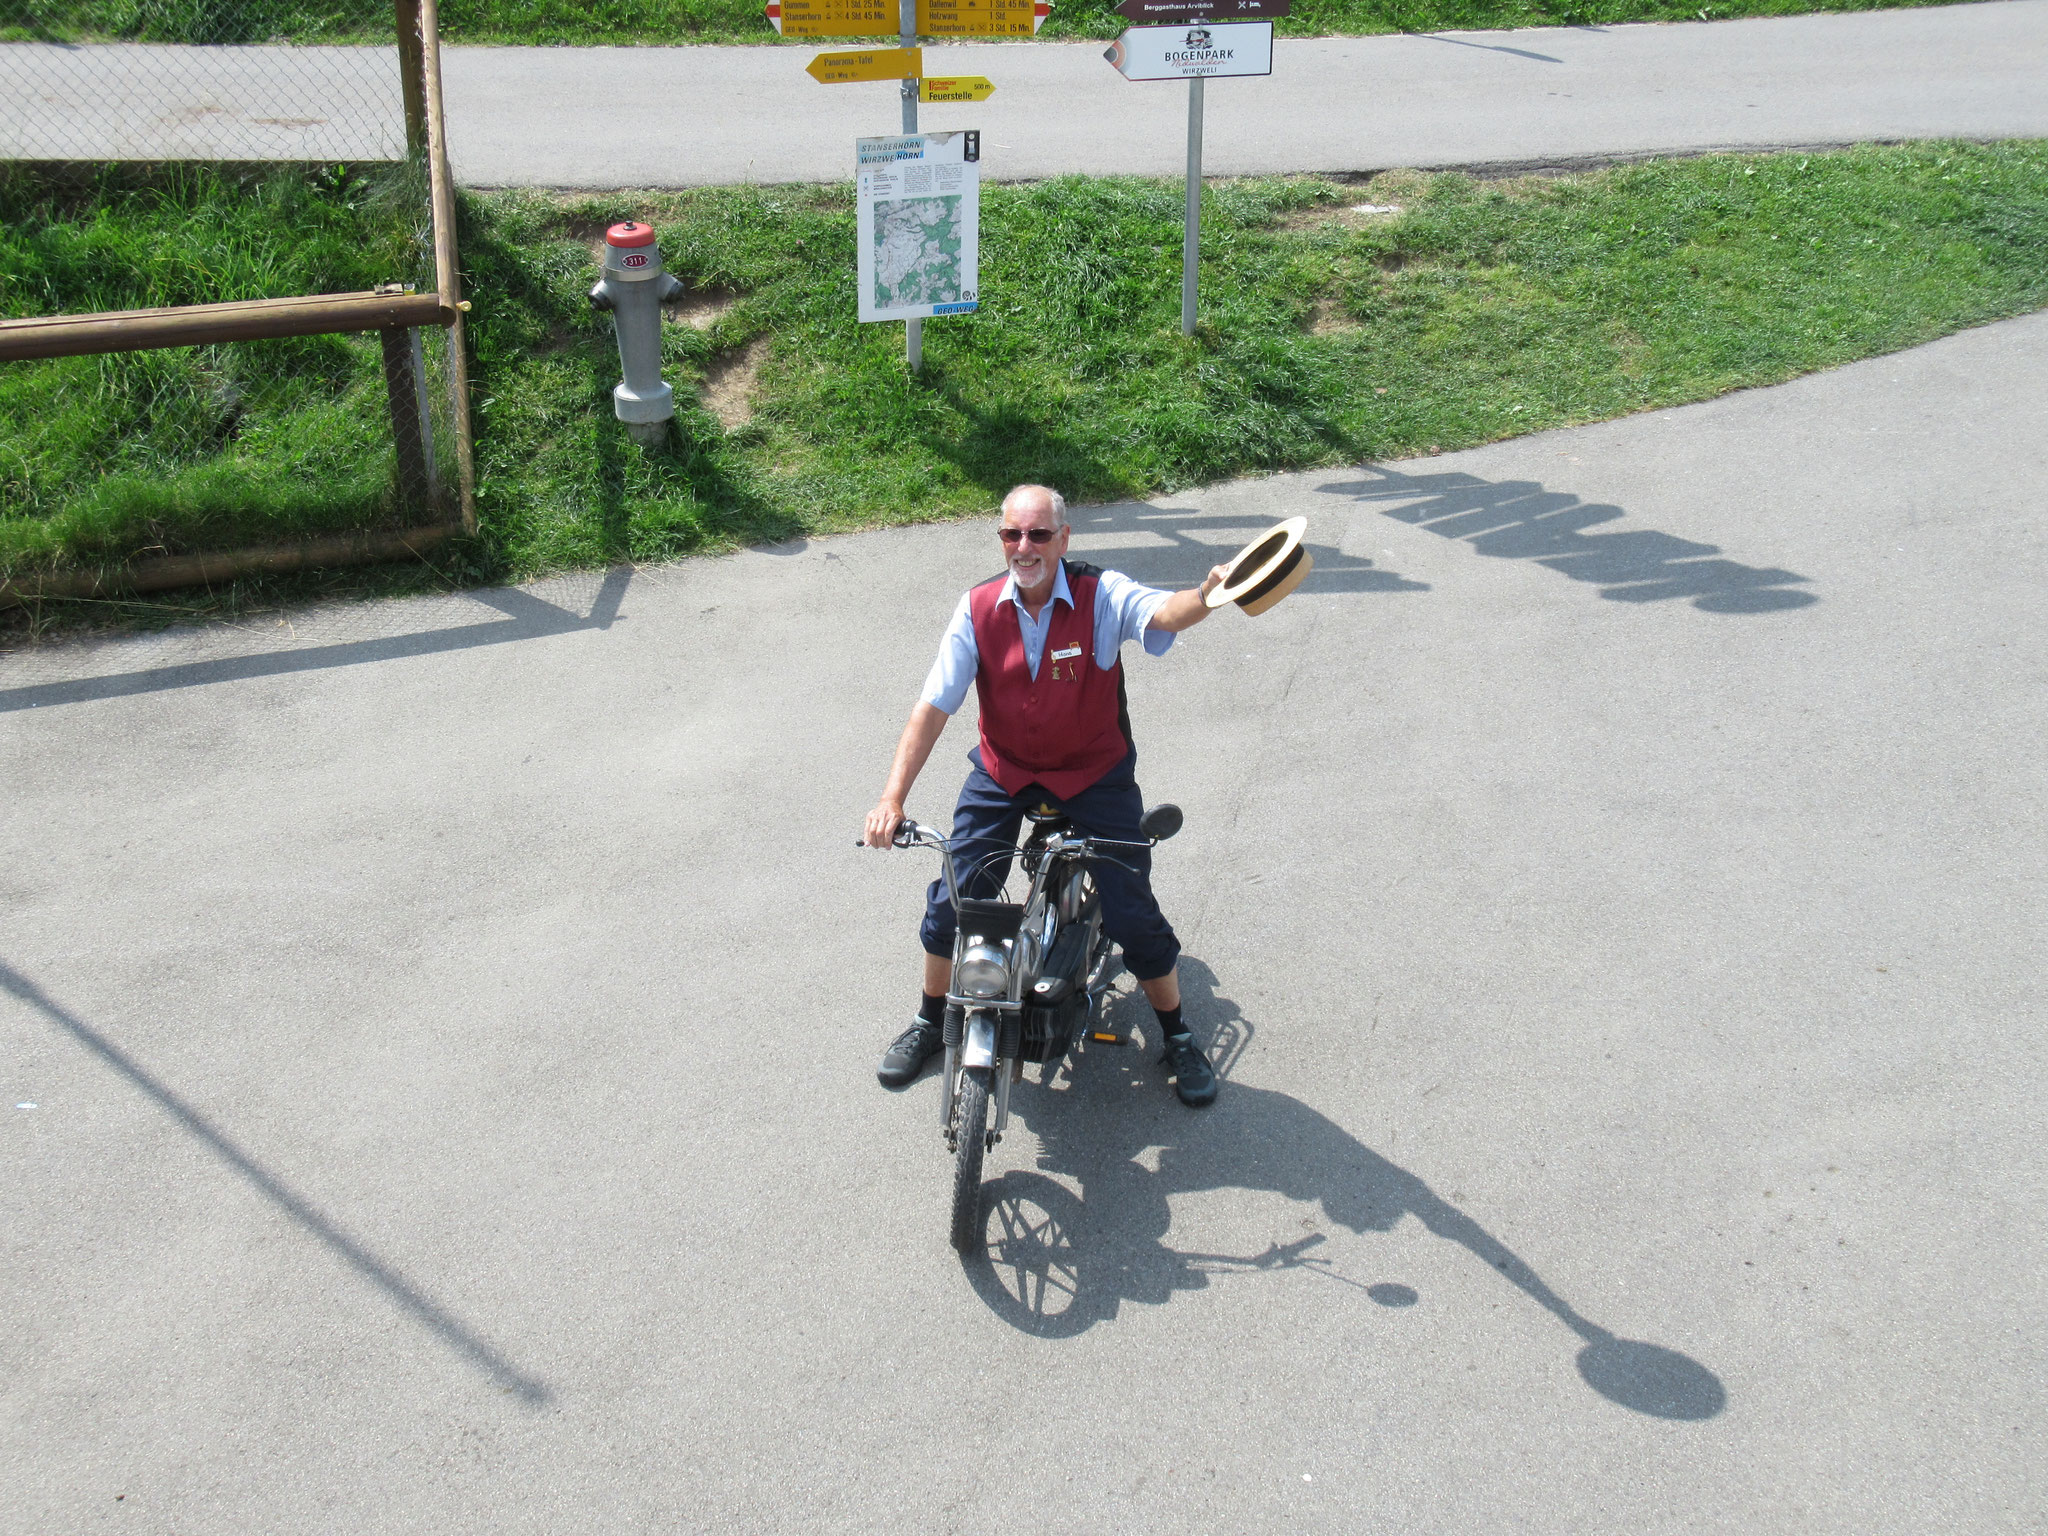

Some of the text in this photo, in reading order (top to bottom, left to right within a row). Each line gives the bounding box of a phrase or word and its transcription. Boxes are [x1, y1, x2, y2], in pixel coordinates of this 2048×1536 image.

[1144, 3, 1186, 12] Berggasthaus
[784, 12, 822, 21] Stanserhorn
[864, 12, 873, 20] 45
[989, 24, 994, 32] 3
[1010, 24, 1017, 32] 15
[1165, 49, 1234, 62] BOGENPARK
[929, 92, 973, 101] Feuerstelle
[862, 142, 921, 152] STANSERHORN
[629, 257, 642, 265] 311
